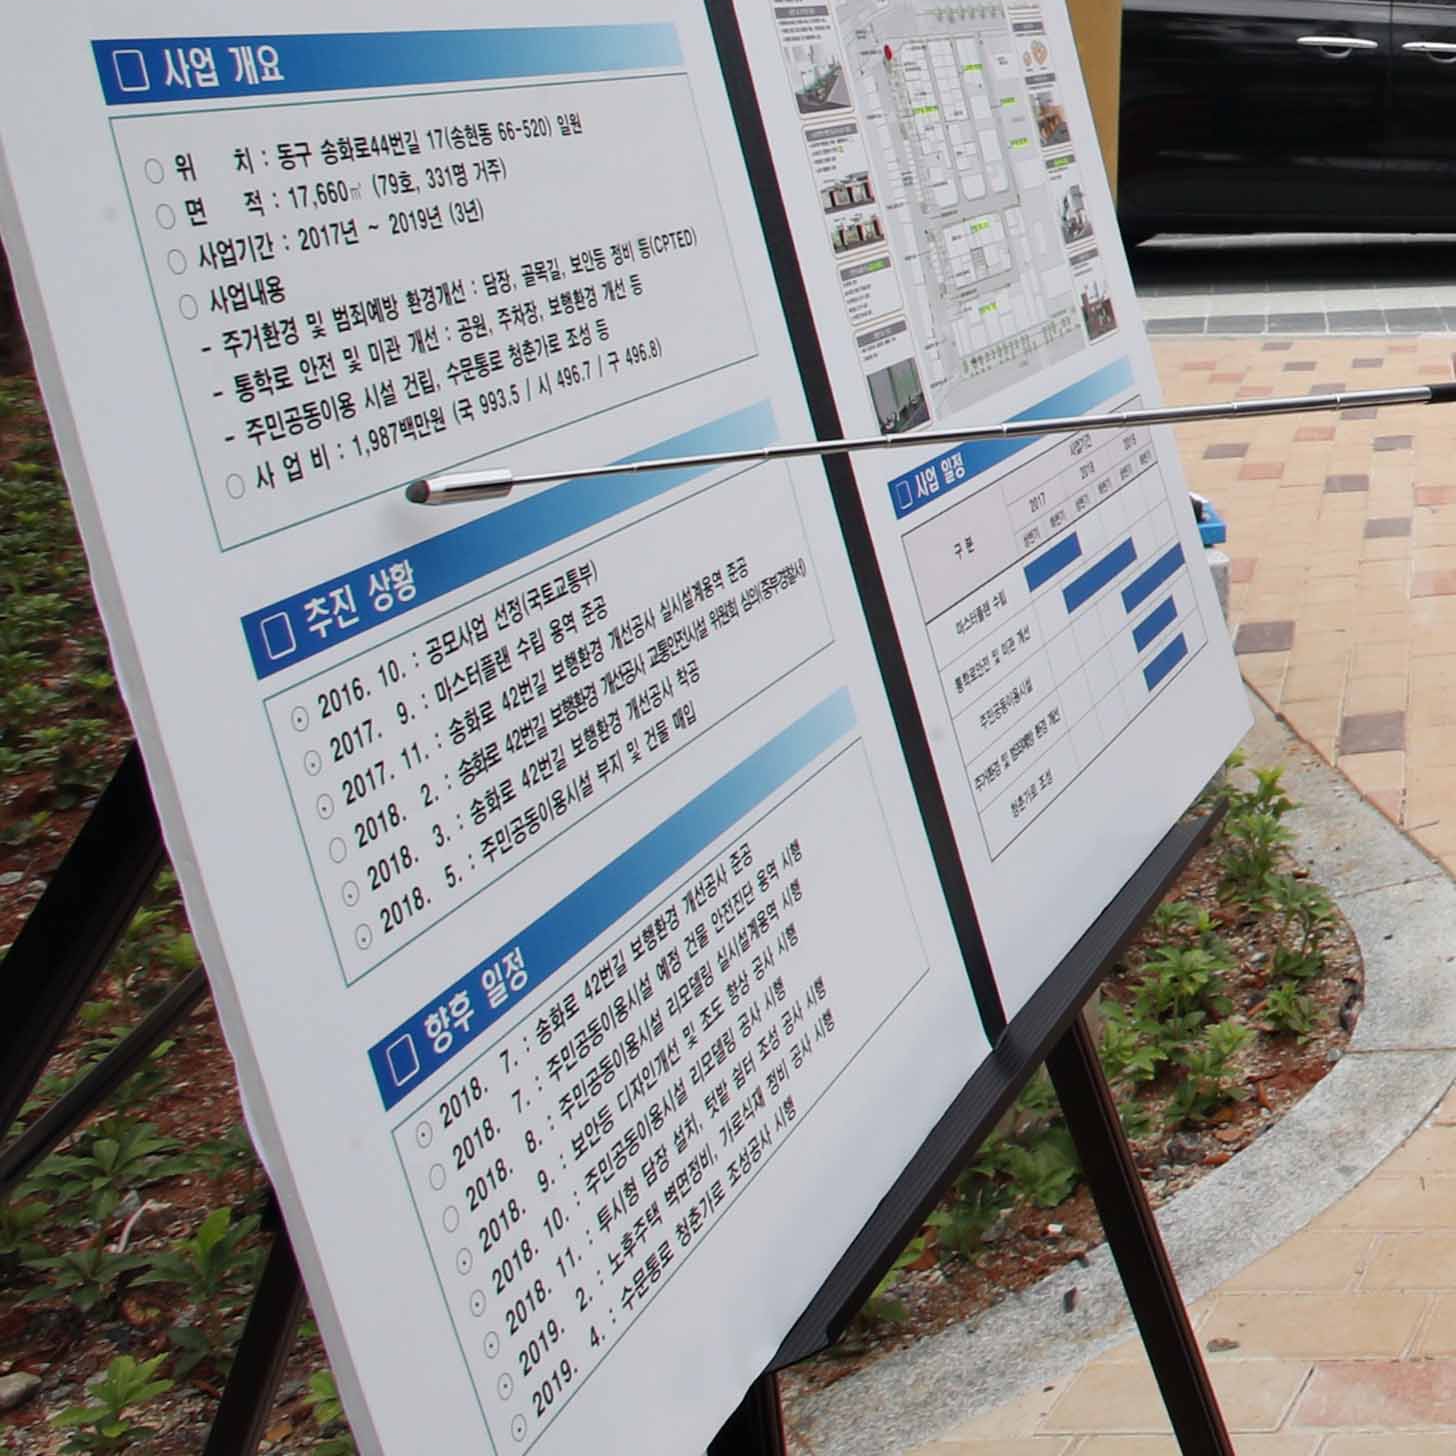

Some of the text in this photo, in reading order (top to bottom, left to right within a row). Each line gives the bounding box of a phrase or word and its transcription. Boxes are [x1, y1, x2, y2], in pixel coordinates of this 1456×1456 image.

[164, 45, 284, 88] 사업 개요
[174, 111, 583, 182] 위 치 동구 송화로44번길 17(송현동 66-520) 일원
[183, 196, 208, 227] 면
[242, 188, 265, 217] 적
[371, 169, 421, 199] (79호,
[424, 161, 469, 189] 331명
[471, 156, 507, 183] 거주)
[198, 197, 484, 270] 사업기간 2017년 2019년 (3년)
[209, 274, 286, 314] 사업내용
[220, 315, 300, 359] 주거환경
[304, 309, 327, 340] 및
[330, 292, 399, 333] 범죄예방
[404, 278, 467, 315] 환경개선
[481, 267, 517, 297] 담장,
[519, 256, 566, 288] 골목길,
[568, 247, 607, 274] 보안등
[232, 277, 627, 403] 통학로 안전 및 미관 개선 공원, 주차장, 보행환경 개선
[244, 317, 610, 447] 주민공동이용 시설 건립, 수문통로 청춘가로 조성 등
[255, 336, 662, 489] 사 업 비 1,987백만원 (국 993.5 시 496.7 구 496.8)
[915, 455, 964, 497] 사업 일정
[303, 559, 416, 638] 추진 상황
[316, 558, 598, 719] 2016. 10. 공모사업 선정(국토교통부)
[328, 594, 608, 763] 2017. 9. 마스터플랜 수립 용역 준공
[341, 606, 656, 806] 2017. 11. 송화로 42번길 보행환경 개선공사
[353, 680, 599, 848] 2018. 2. 송화로 42번길 보행환경
[366, 843, 419, 891] 2018.
[431, 822, 451, 848] 3.
[469, 777, 517, 826] 송화로
[521, 743, 568, 789] 42번길
[569, 707, 623, 758] 보행환경
[624, 675, 674, 721] 개선공사
[378, 736, 642, 934] 2018. 5. 주민공동이용시설 부지 및
[424, 946, 527, 1053] 향후 일정
[438, 1075, 488, 1129] 2018.
[498, 1047, 518, 1074] 7.
[535, 991, 580, 1046] 송화로
[583, 948, 628, 1000] 42번길
[451, 970, 654, 1171] 2018. 7. 주민공동이용시설
[464, 1157, 513, 1213] 2018.
[523, 1128, 543, 1154] 8.
[557, 1006, 664, 1120] 주민공동이용시설
[477, 1036, 682, 1254] 2018. 9. 보안등 디자인개선
[491, 1237, 539, 1295] 2018.
[542, 1206, 569, 1239] 10.
[583, 1076, 688, 1195] 주민공동이용시설
[504, 1277, 552, 1336] 2018.
[554, 1245, 582, 1278] 11.
[595, 1175, 640, 1233] 투시형
[517, 1317, 565, 1377] 2019.
[574, 1285, 593, 1312] 2.
[606, 1199, 663, 1276] 노후주택
[531, 1357, 578, 1418] 2019.
[589, 1324, 606, 1347] 4.
[619, 1239, 675, 1311] 수문통로
